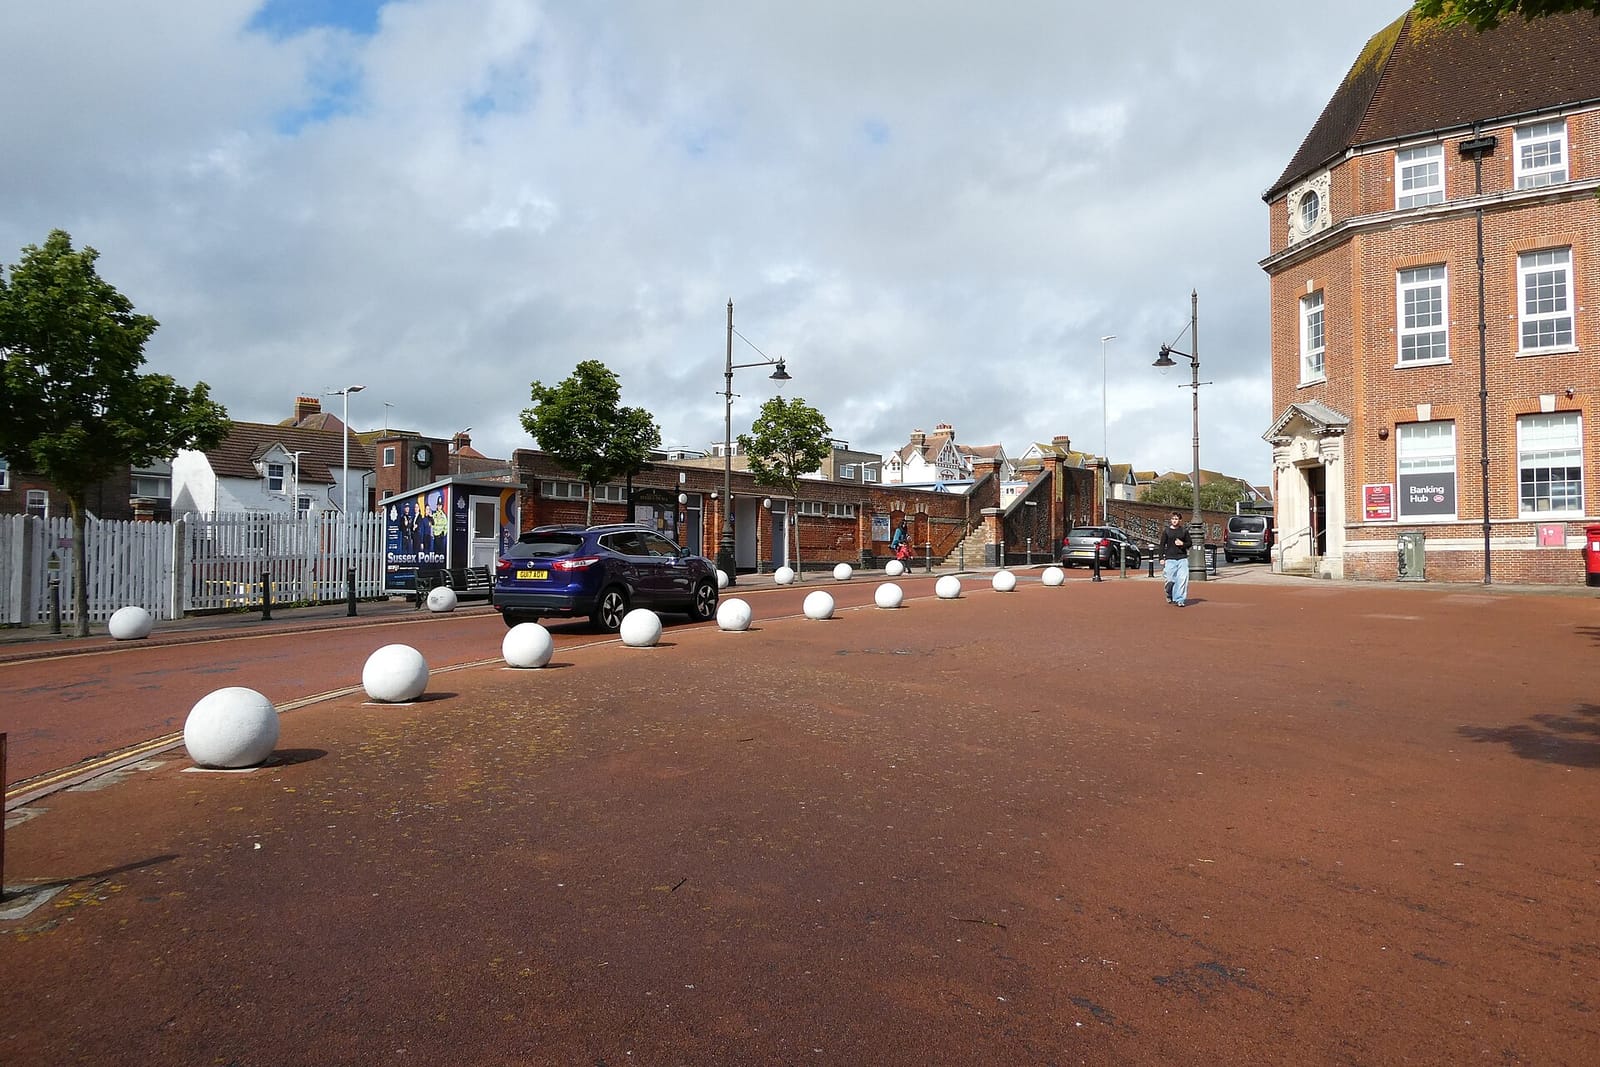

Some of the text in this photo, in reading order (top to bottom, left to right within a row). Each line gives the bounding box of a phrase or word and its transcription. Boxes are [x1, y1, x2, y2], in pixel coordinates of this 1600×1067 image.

[1409, 485, 1444, 495] Banking
[1409, 494, 1429, 503] Hub
[387, 551, 445, 563] Sussex Police
